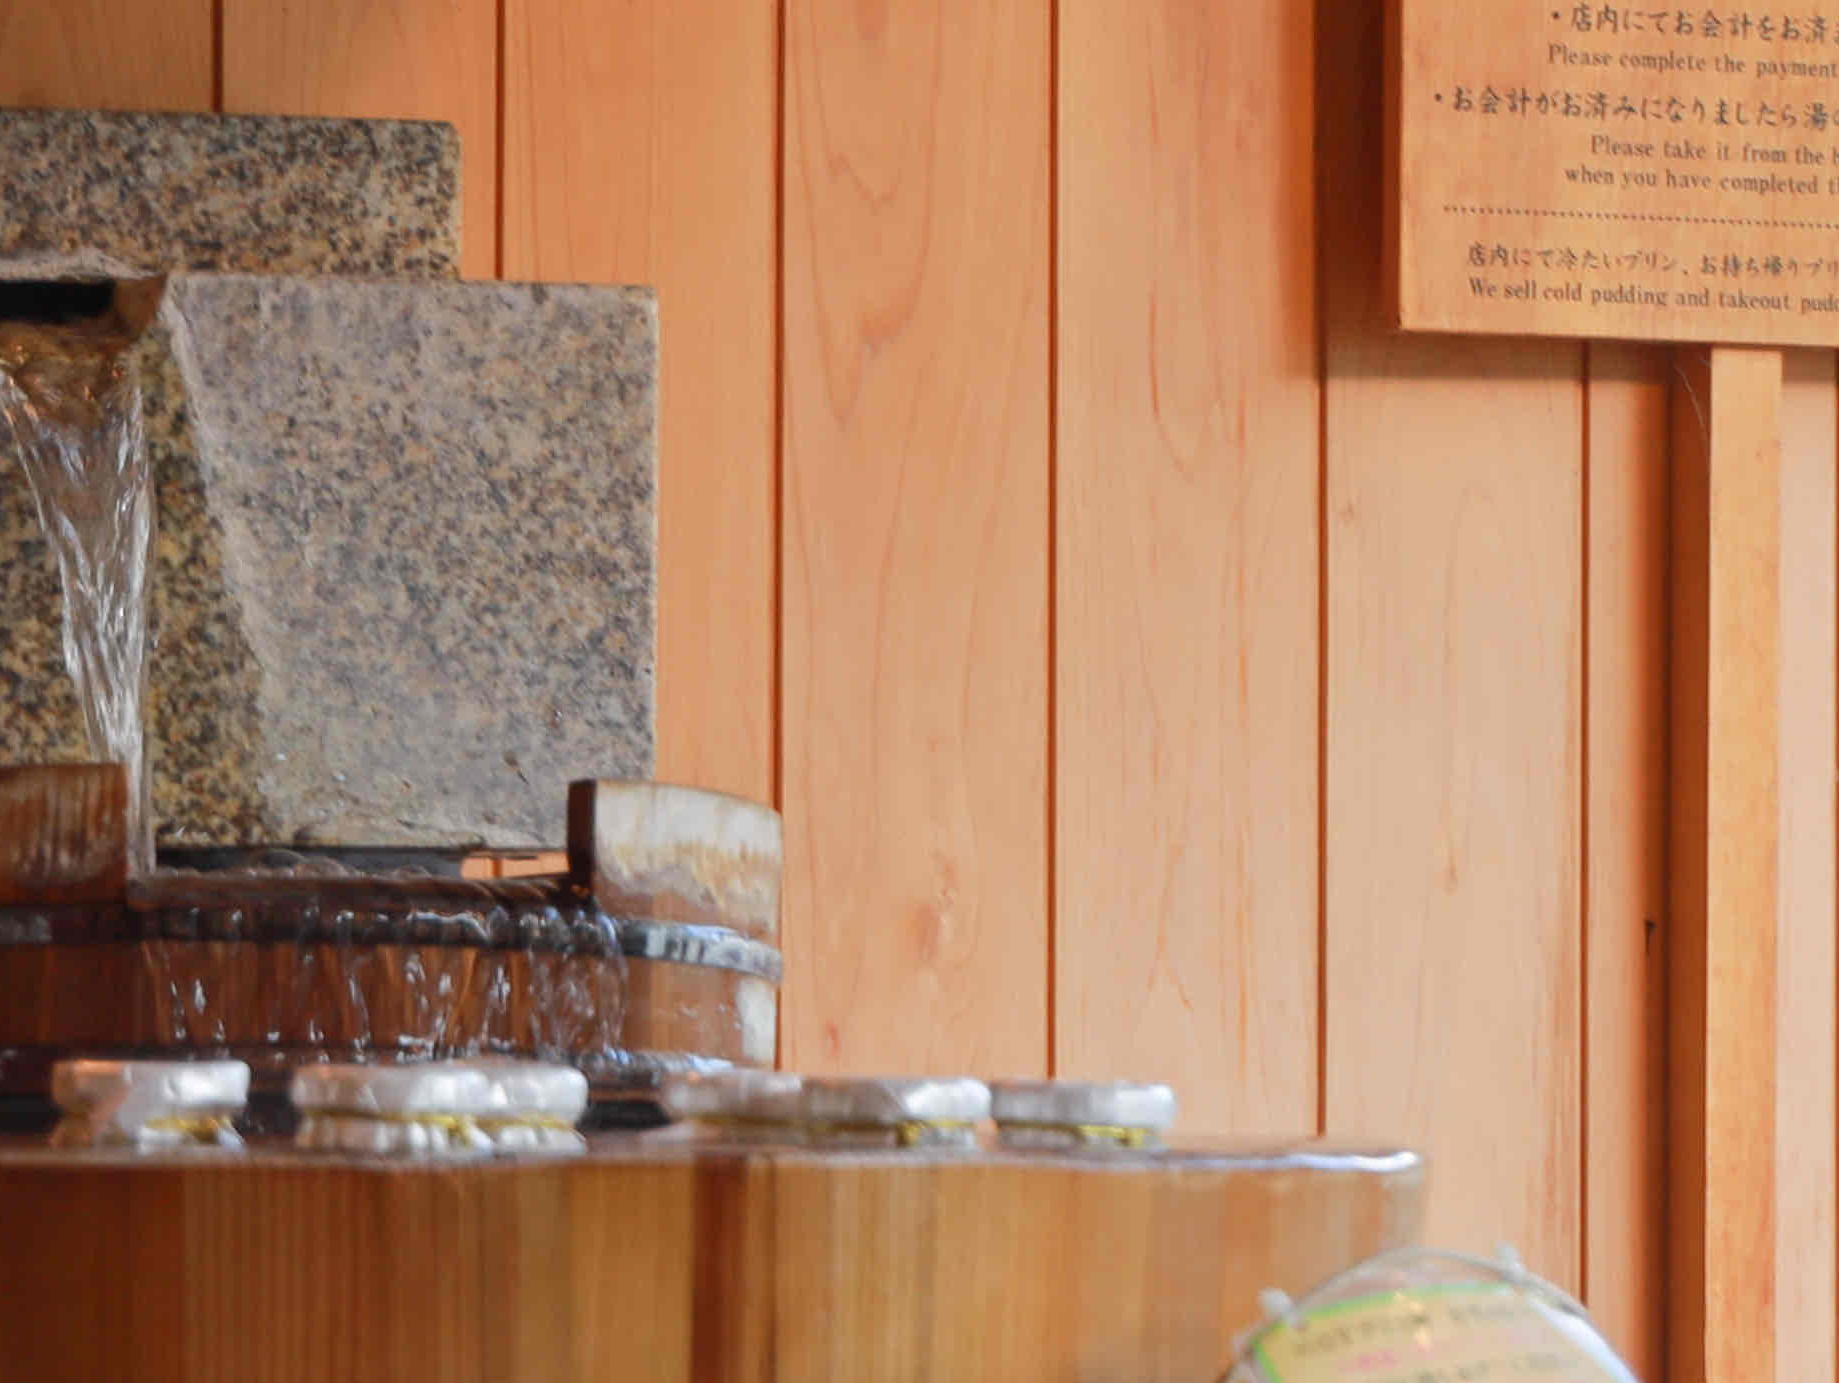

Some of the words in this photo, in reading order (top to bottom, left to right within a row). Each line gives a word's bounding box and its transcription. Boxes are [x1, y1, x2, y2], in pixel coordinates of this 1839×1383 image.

[1548, 42, 1612, 66] Please
[1620, 51, 1706, 73] complete
[1715, 53, 1746, 73] the
[1756, 61, 1838, 81] payment
[1591, 134, 1654, 158] Please
[1664, 140, 1706, 160] take
[1717, 142, 1730, 162] it
[1742, 143, 1787, 164] from
[1795, 145, 1825, 166] the
[1565, 164, 1613, 185] when
[1622, 171, 1656, 188] you
[1666, 169, 1711, 190] have
[1721, 175, 1818, 196] completed
[1469, 276, 1498, 298] We
[1504, 280, 1537, 300] sell
[1543, 282, 1583, 303] cold
[1591, 284, 1668, 308] pudding
[1675, 288, 1710, 308] and
[1719, 290, 1790, 312] takeout
